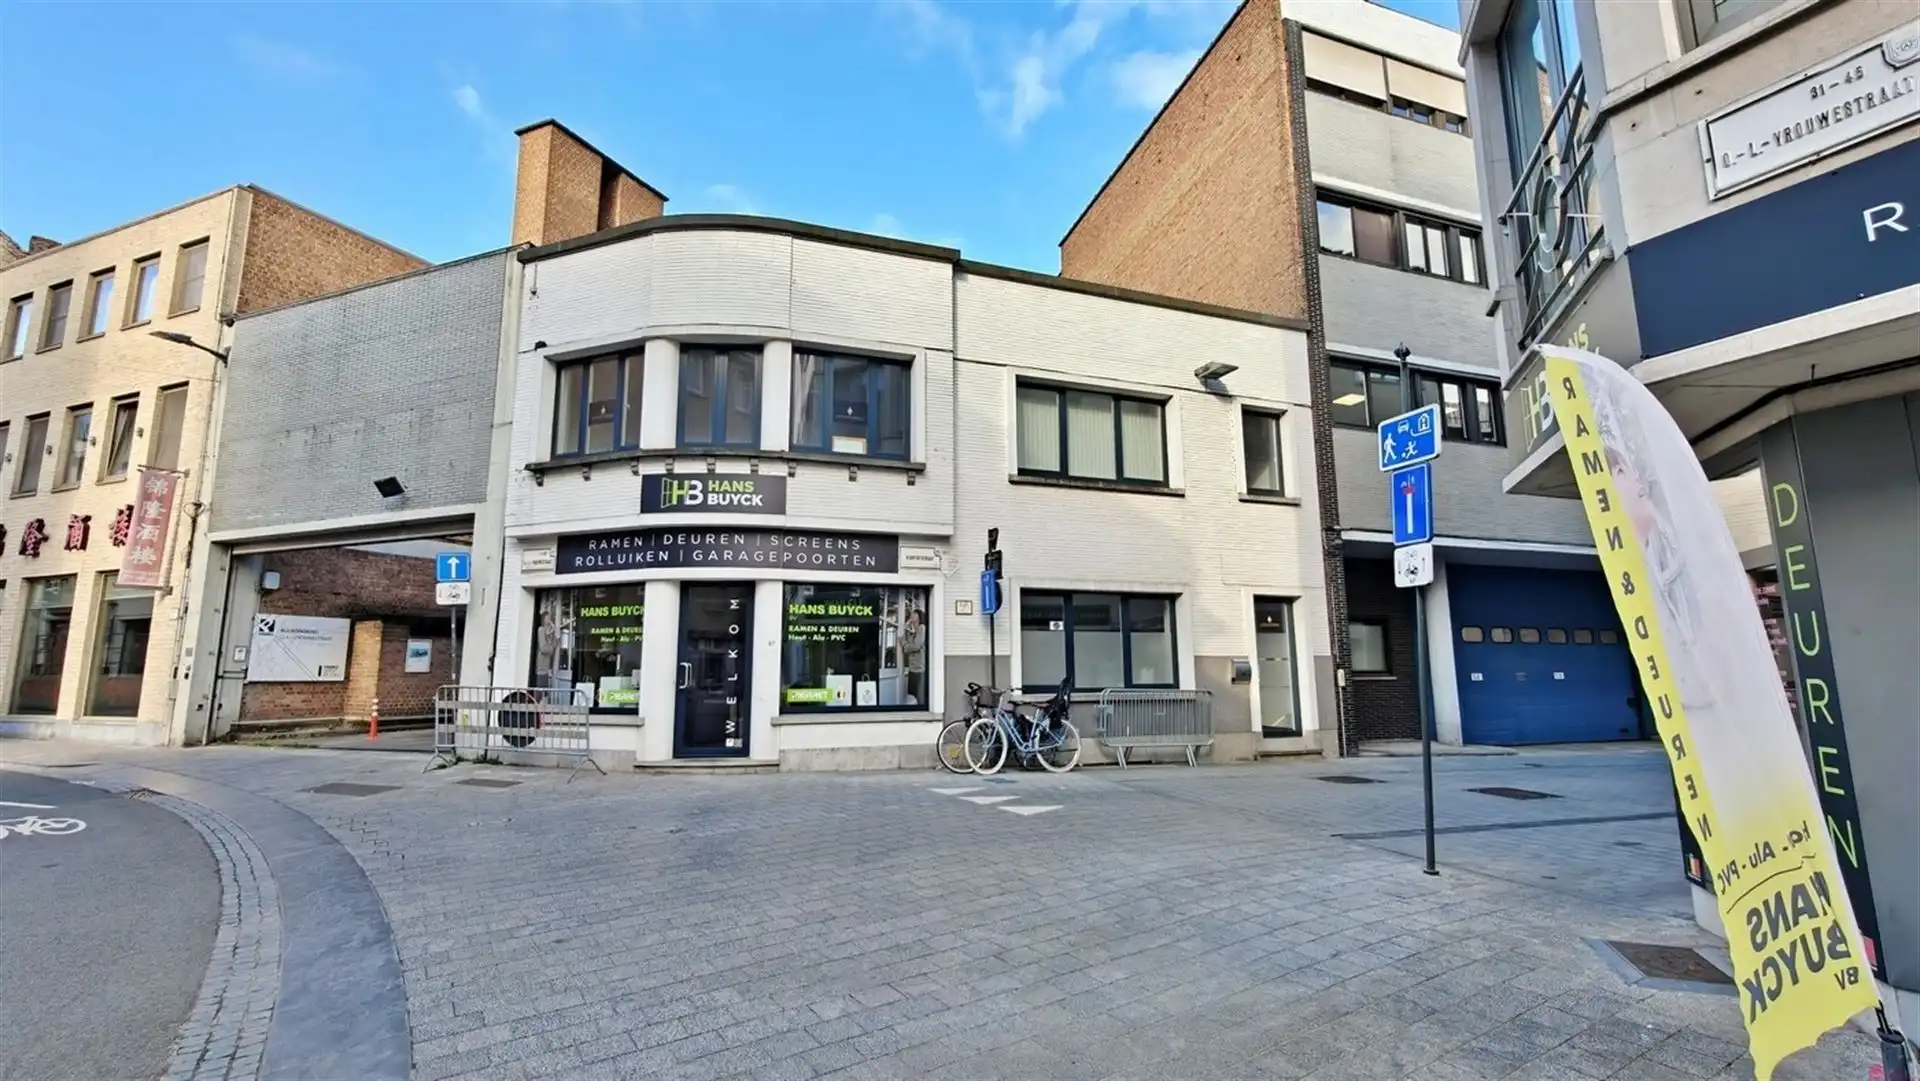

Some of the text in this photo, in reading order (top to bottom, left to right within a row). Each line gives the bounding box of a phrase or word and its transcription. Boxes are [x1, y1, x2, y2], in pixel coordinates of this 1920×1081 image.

[708, 480, 755, 493] HANS
[707, 493, 763, 506] BUYCK
[588, 533, 860, 550] RAMEN DEUREN SCREENS
[575, 549, 876, 567] ROLLUIKEN GARAGEPOORTEN
[581, 606, 609, 617] HANS
[788, 604, 873, 616] HANS BUYCK
[725, 599, 740, 734] WELKOM
